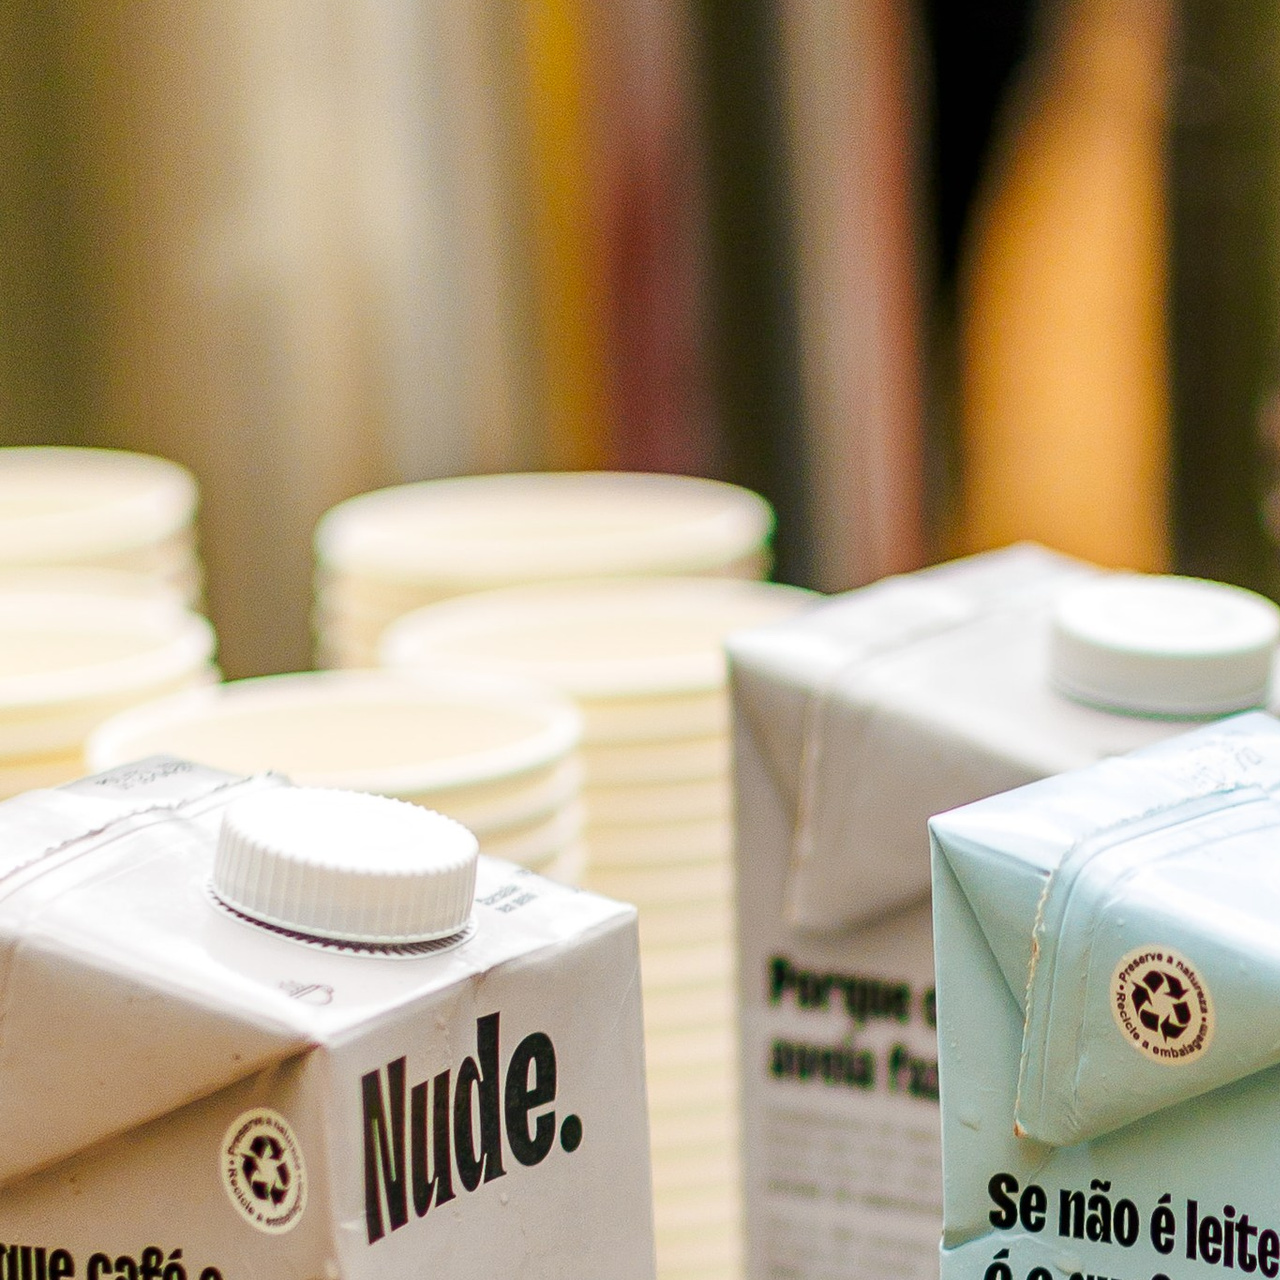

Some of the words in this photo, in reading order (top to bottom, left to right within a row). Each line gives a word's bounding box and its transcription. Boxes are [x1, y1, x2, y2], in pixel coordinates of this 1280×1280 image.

[1118, 953, 1163, 983] Preserve
[1166, 956, 1173, 965] a
[1116, 992, 1140, 1041] Recicle
[361, 1011, 583, 1246] Nude.
[987, 1172, 1048, 1233] Se
[1058, 1178, 1140, 1248] não
[1150, 1192, 1176, 1255] é
